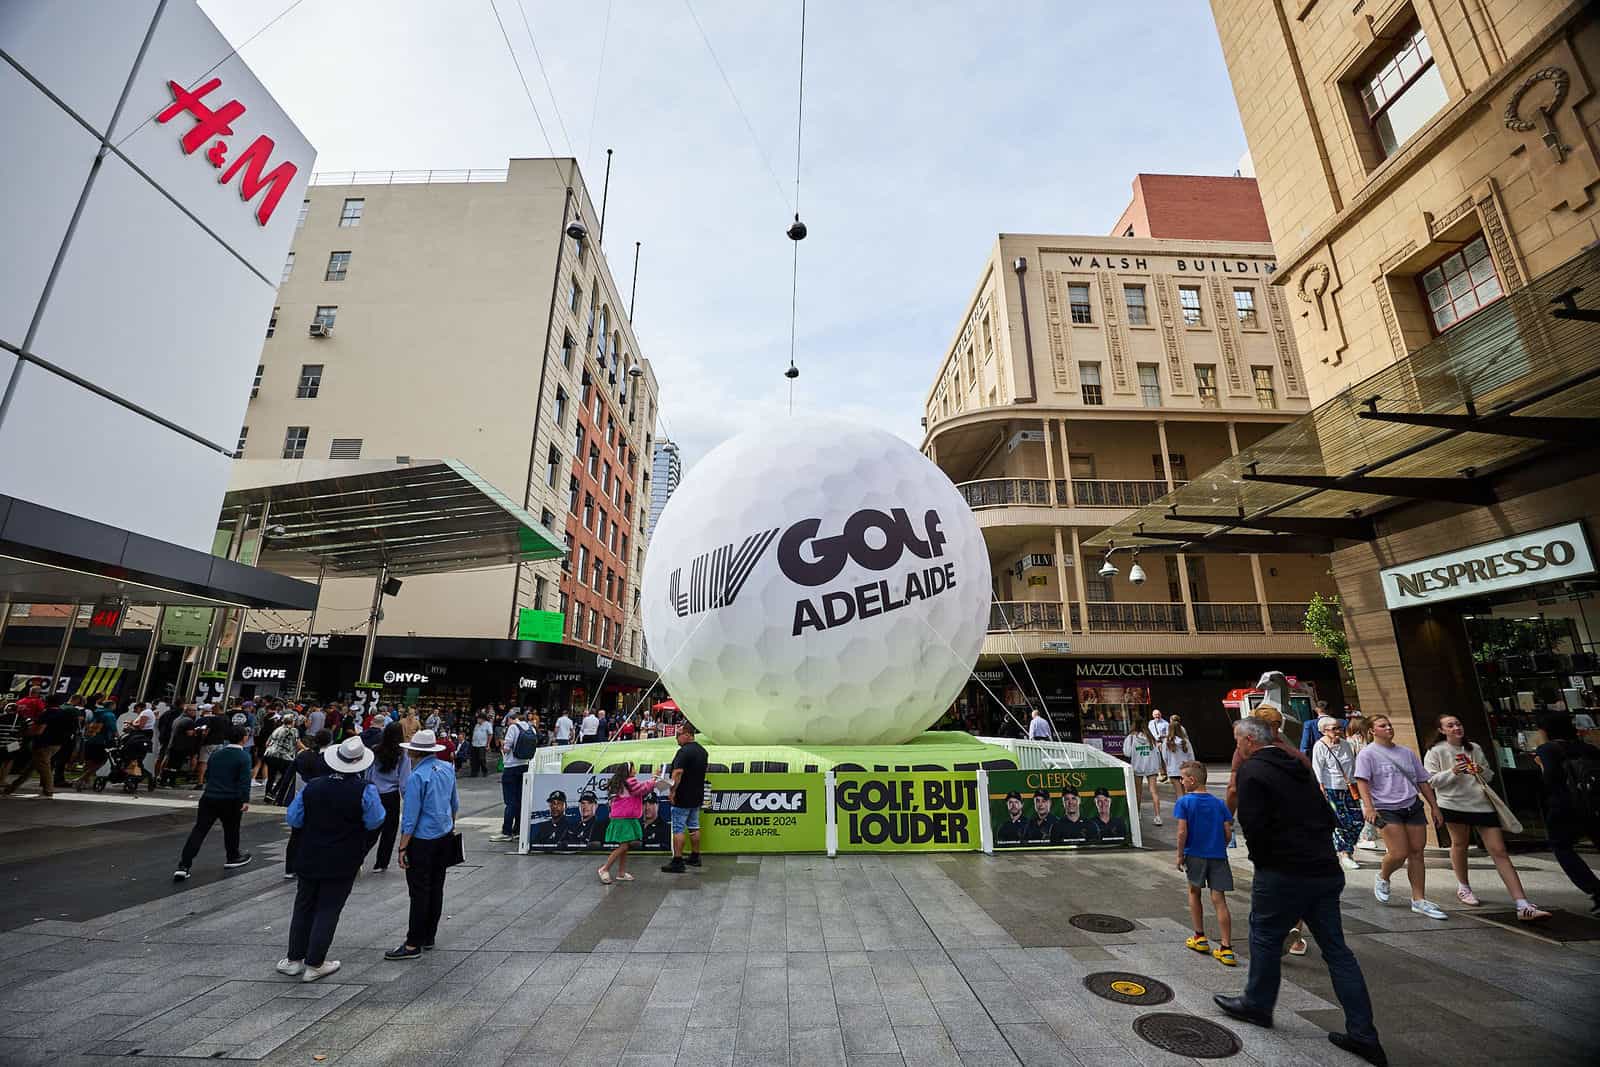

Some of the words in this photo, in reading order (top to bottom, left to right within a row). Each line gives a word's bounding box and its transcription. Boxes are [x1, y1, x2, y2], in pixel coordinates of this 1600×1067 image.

[155, 78, 298, 226] H&M
[1069, 256, 1147, 270] WALSH
[670, 527, 780, 617] LIV
[777, 508, 946, 586] GOLF
[1389, 540, 1575, 598] NESPRESSO
[792, 562, 956, 636] ADELAIDE
[282, 635, 329, 648] HYPE
[253, 669, 287, 678] HYPE
[395, 673, 429, 682] HYPE
[1076, 663, 1184, 676] MAZZUCCHELLI'S
[750, 792, 803, 810] GOLF
[836, 780, 919, 812] GOLF,
[924, 780, 977, 811] BUT
[714, 817, 770, 826] ADELAIDE
[773, 817, 797, 826] 2024
[849, 813, 969, 844] LOUDER
